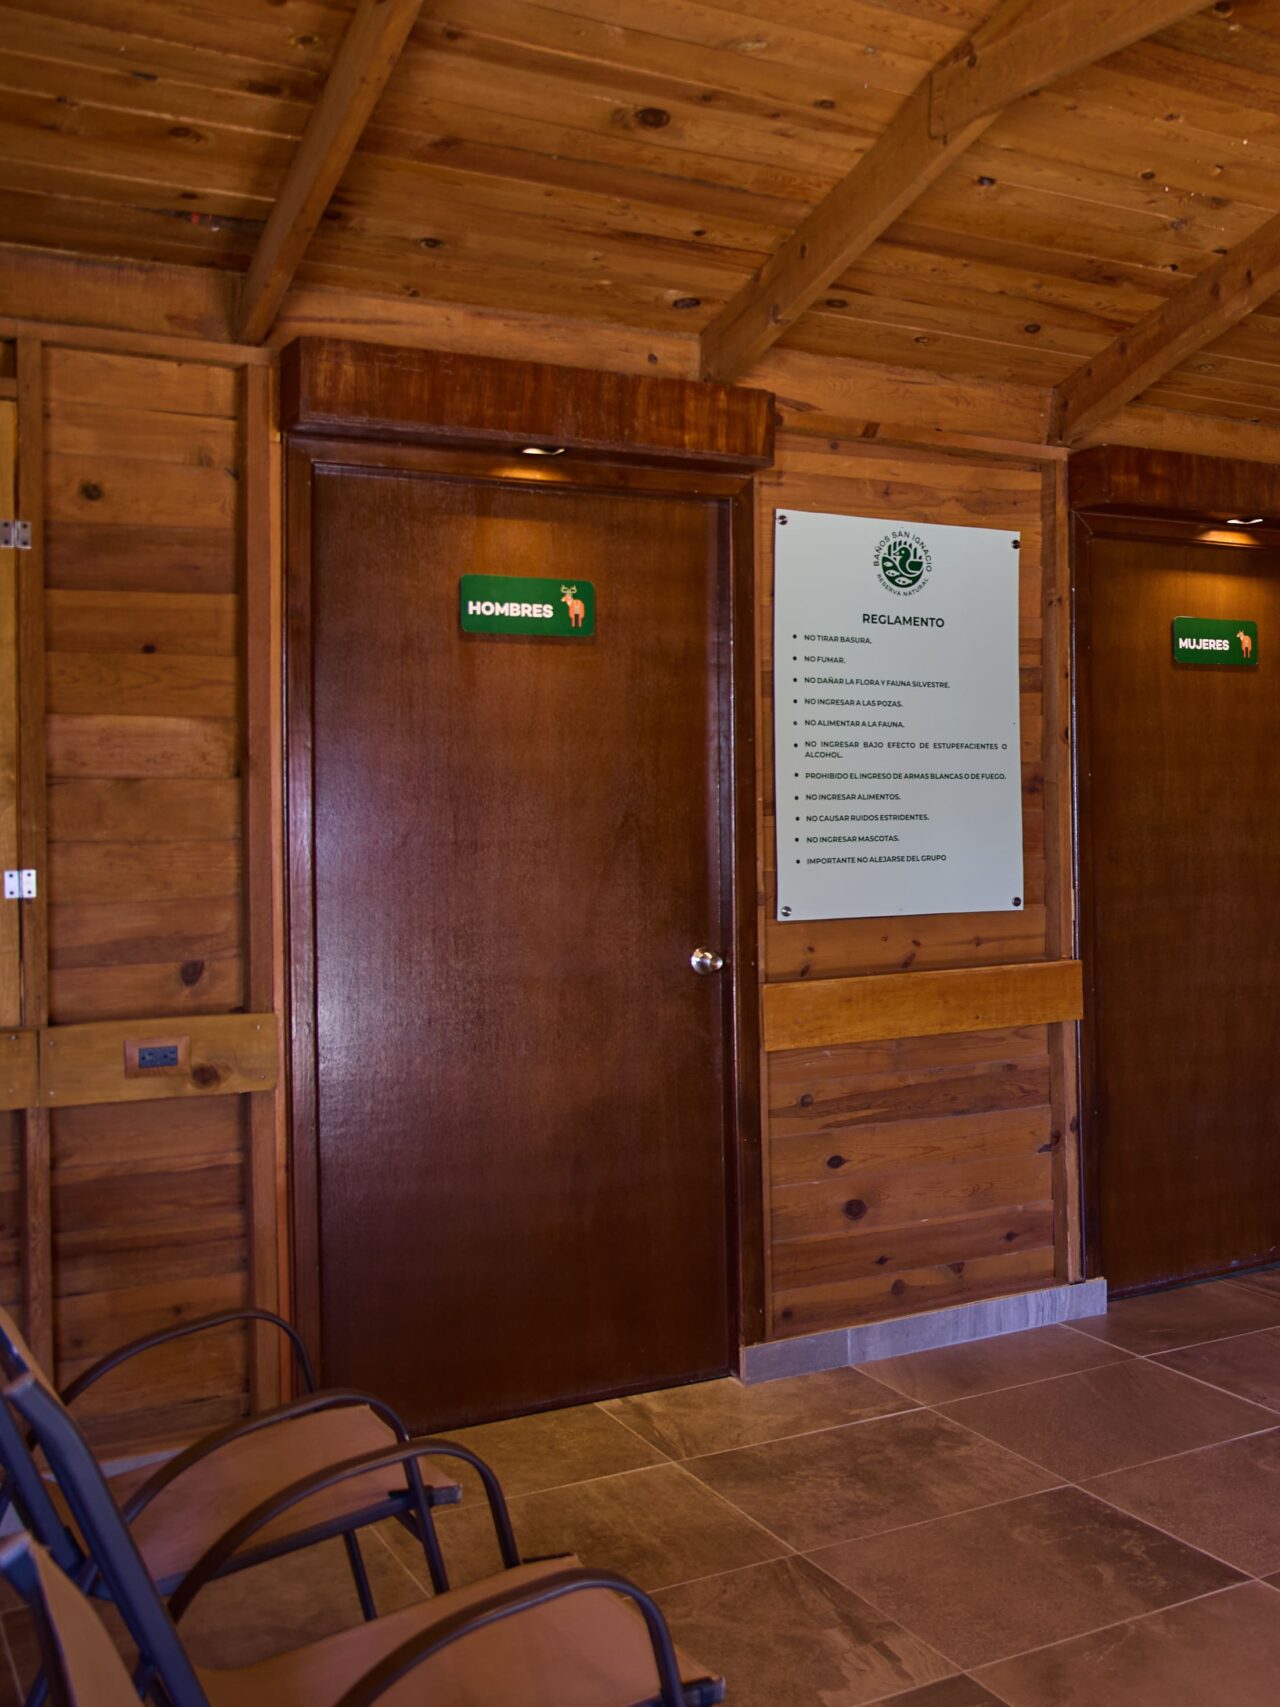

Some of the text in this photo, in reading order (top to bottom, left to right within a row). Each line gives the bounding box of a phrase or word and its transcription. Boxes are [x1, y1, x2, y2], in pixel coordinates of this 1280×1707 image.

[873, 531, 932, 573] BAÑOS SAN IGNACIO
[877, 574, 928, 597] RESERVA NATURAL
[468, 600, 553, 618] HOMBRES
[862, 613, 944, 628] REGLAMENTO
[840, 636, 872, 644] BASURA.
[1179, 638, 1230, 651] MUJERES
[817, 656, 846, 664] FUMAR.
[817, 677, 844, 685] DAÑAR
[887, 680, 911, 688] FAUNA
[912, 681, 950, 689] SILVESTRE.
[933, 742, 998, 750] ESTUPEFACIENTES
[806, 772, 848, 780] PROHIBIDO
